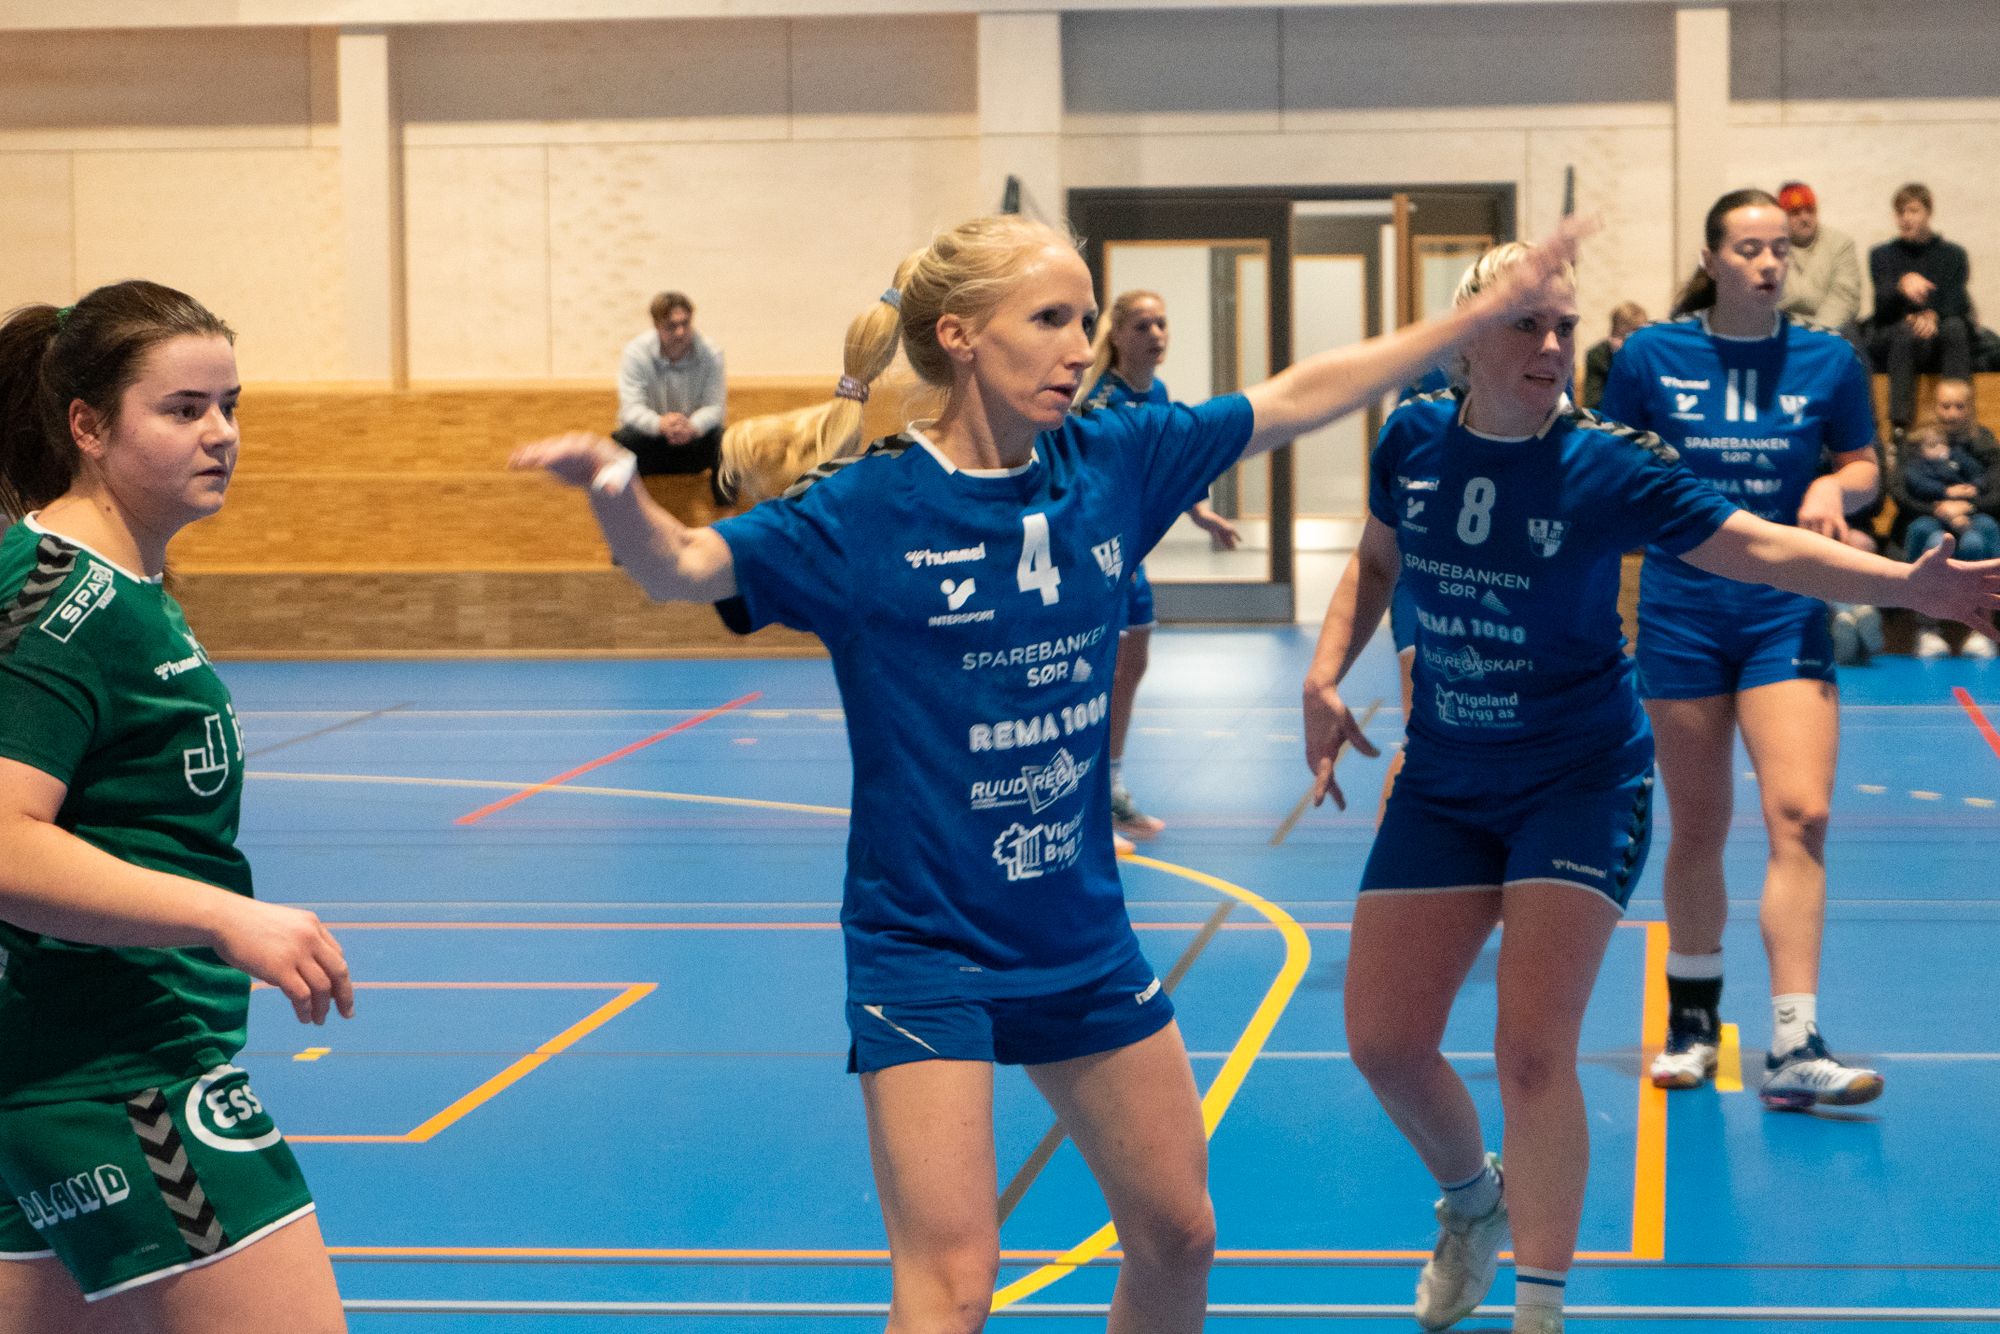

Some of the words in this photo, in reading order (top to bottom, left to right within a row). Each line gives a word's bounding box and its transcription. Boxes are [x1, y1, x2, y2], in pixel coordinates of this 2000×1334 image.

[1726, 369, 1757, 422] 11
[1684, 437, 1790, 450] SPAREBANKEN
[1456, 476, 1497, 545] 8
[926, 541, 986, 567] hummel
[1016, 512, 1062, 607] 4
[1404, 553, 1531, 590] SPAREBANKEN
[1438, 580, 1477, 600] SØR
[928, 608, 996, 628] INTERSPORT
[1471, 618, 1527, 645] 1000
[1027, 661, 1070, 688] SØR
[1455, 692, 1519, 708] Vigeland
[1457, 706, 1494, 721] Bygg
[1498, 708, 1516, 719] as
[969, 712, 1060, 753] REMA
[970, 775, 1028, 801] RUUD
[1566, 860, 1608, 879] hummel
